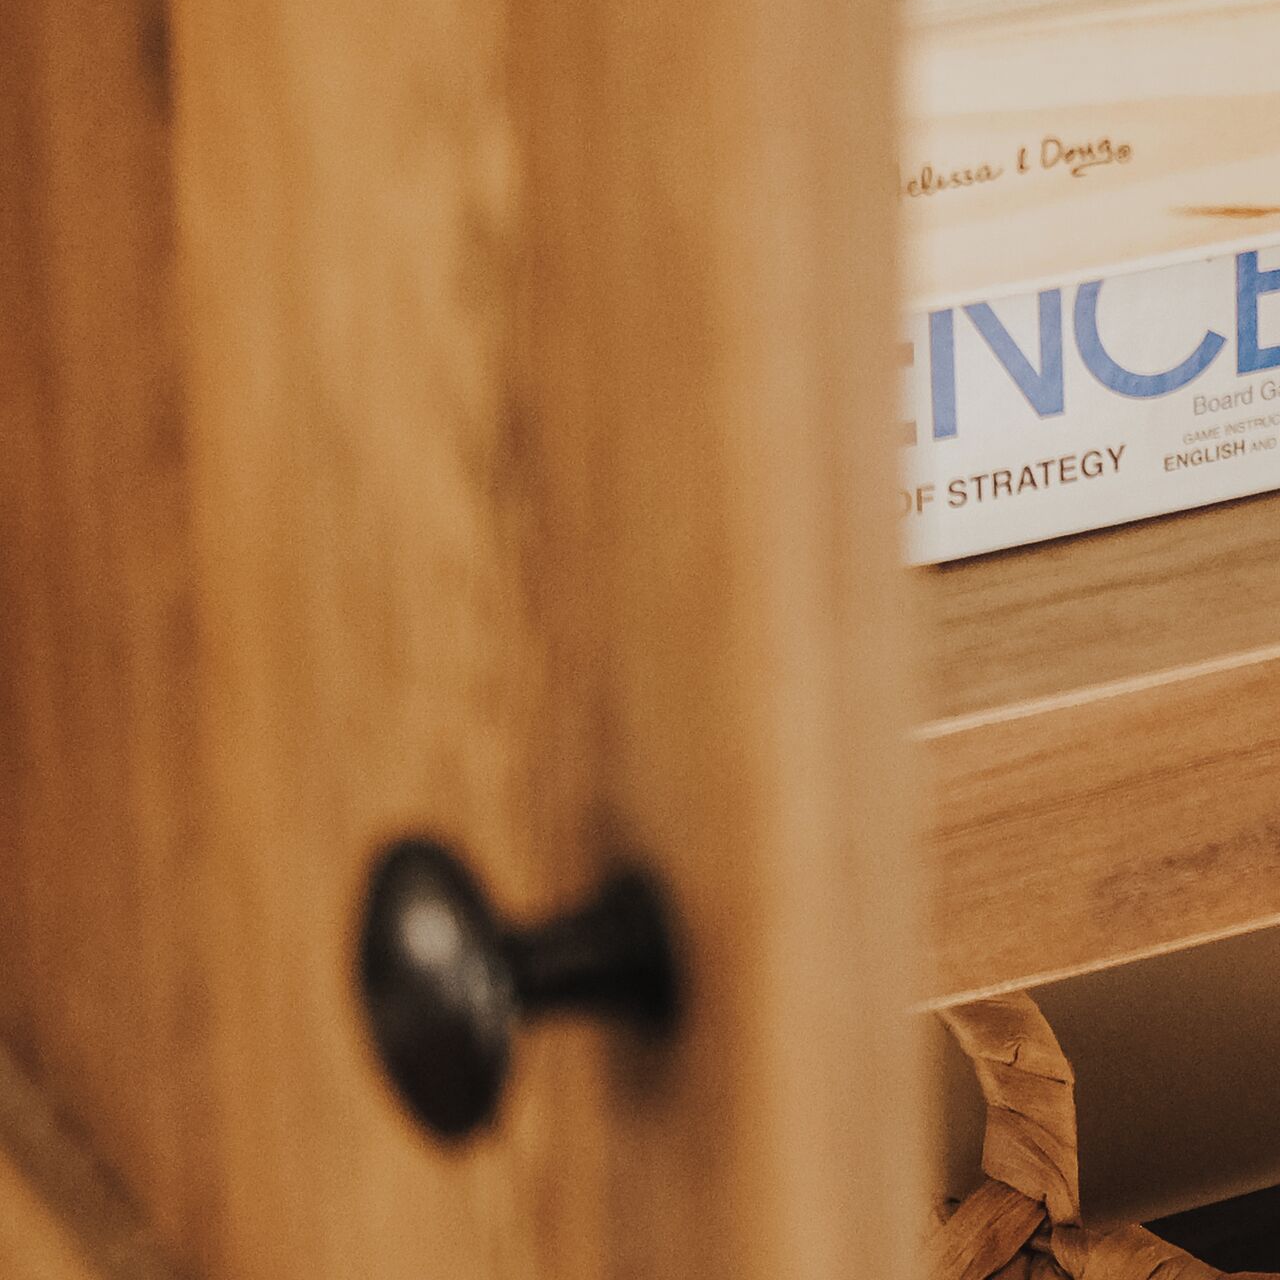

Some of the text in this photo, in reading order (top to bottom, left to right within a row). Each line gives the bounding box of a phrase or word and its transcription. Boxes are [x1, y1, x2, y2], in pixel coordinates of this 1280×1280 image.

[1191, 390, 1255, 417] Board
[1182, 427, 1222, 447] GAME
[1163, 439, 1247, 473] ENGLISH
[1249, 437, 1279, 454] AND
[947, 443, 1128, 510] STRATEGY
